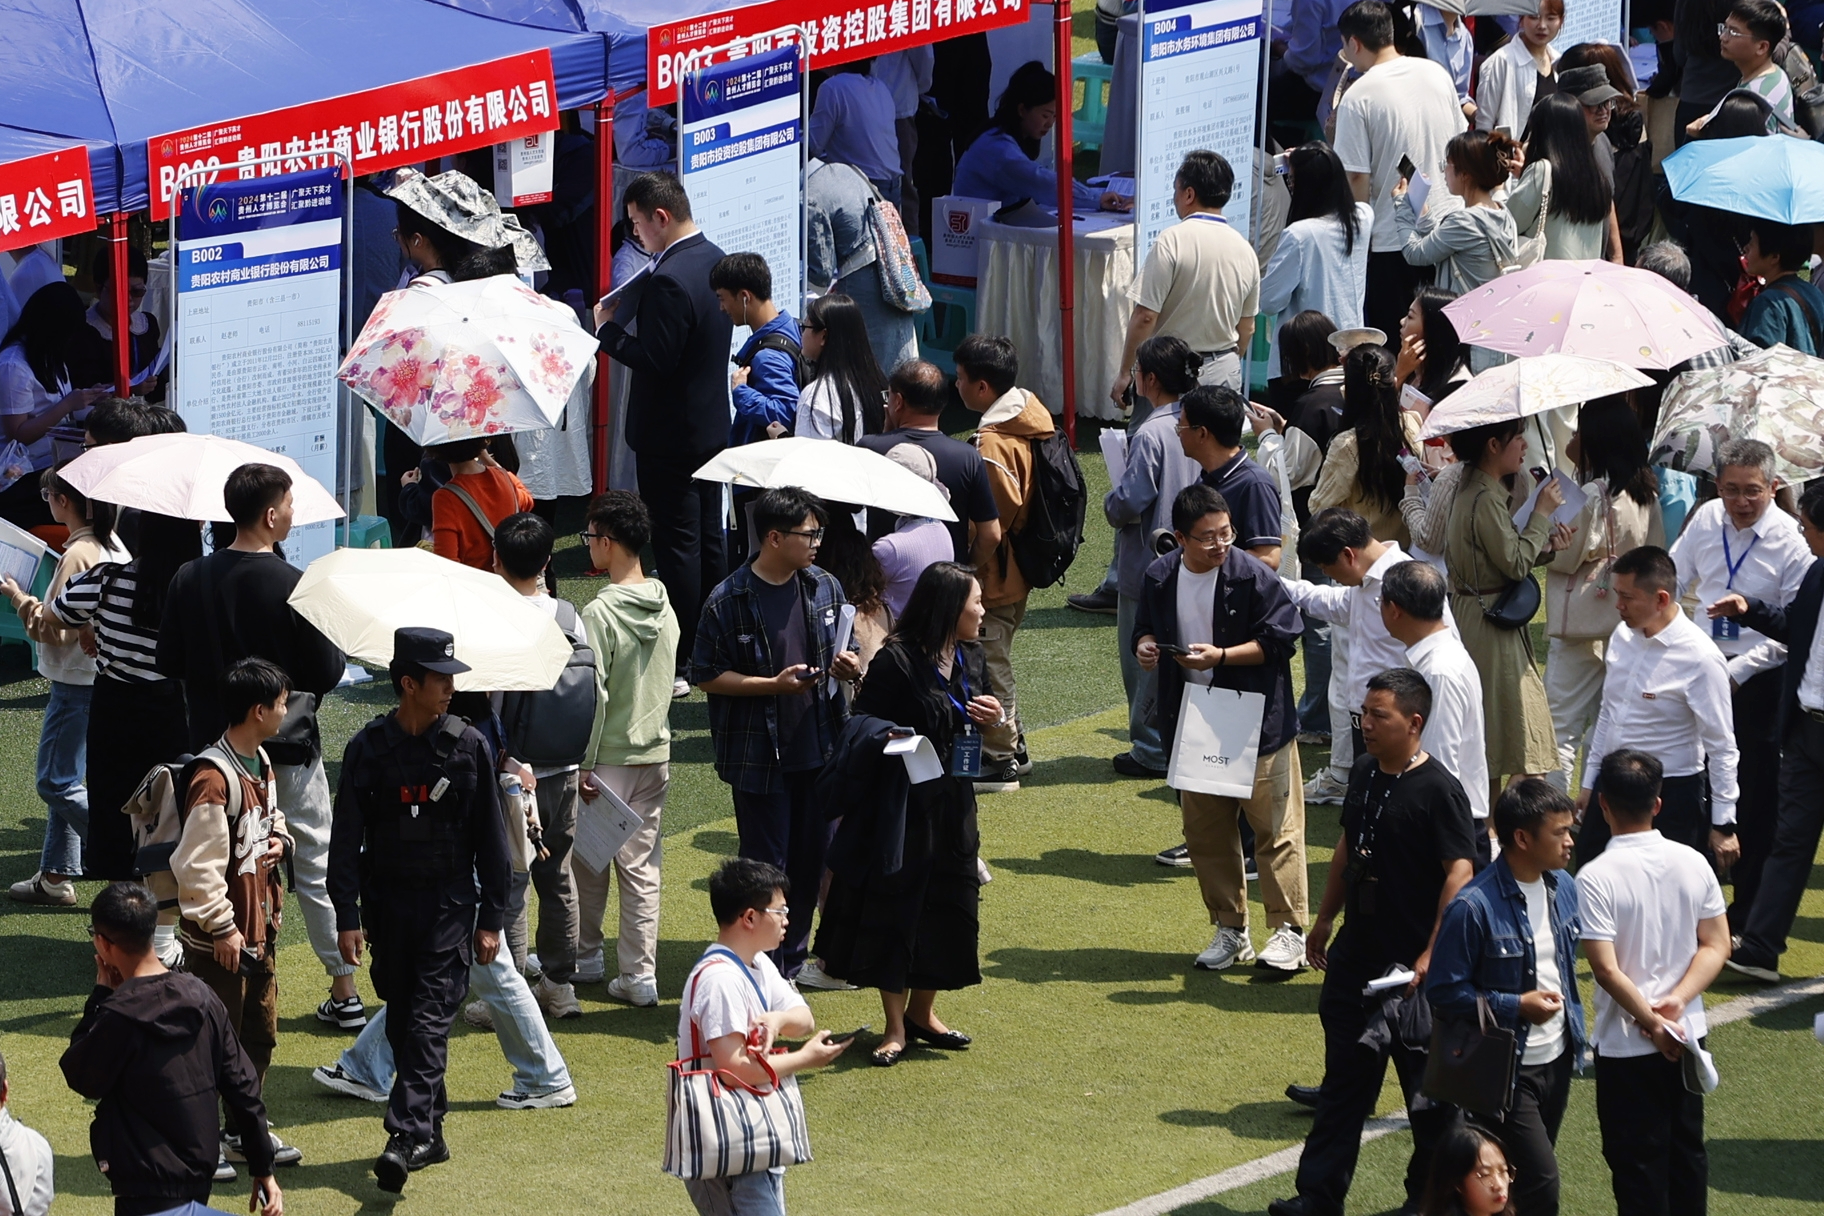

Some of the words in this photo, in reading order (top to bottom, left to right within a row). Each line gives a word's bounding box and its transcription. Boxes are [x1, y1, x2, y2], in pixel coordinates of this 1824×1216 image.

[1154, 19, 1176, 35] B004
[1150, 22, 1256, 58] 贵阳市水务环境集团有限公司
[694, 128, 715, 146] B003
[691, 127, 794, 170] 贵阳市投资控股集团有限公司
[238, 190, 288, 205] 2024第十二届
[291, 184, 332, 198] 广聚天下英才
[238, 201, 287, 215] 贵州人才博览会
[192, 247, 222, 263] B002
[191, 255, 329, 288] 贵阳农村商业银行股份有限公司
[187, 307, 209, 316] 上班地址
[189, 336, 206, 344] 联系人
[259, 325, 270, 334] 电话
[1203, 754, 1230, 765] MOST
